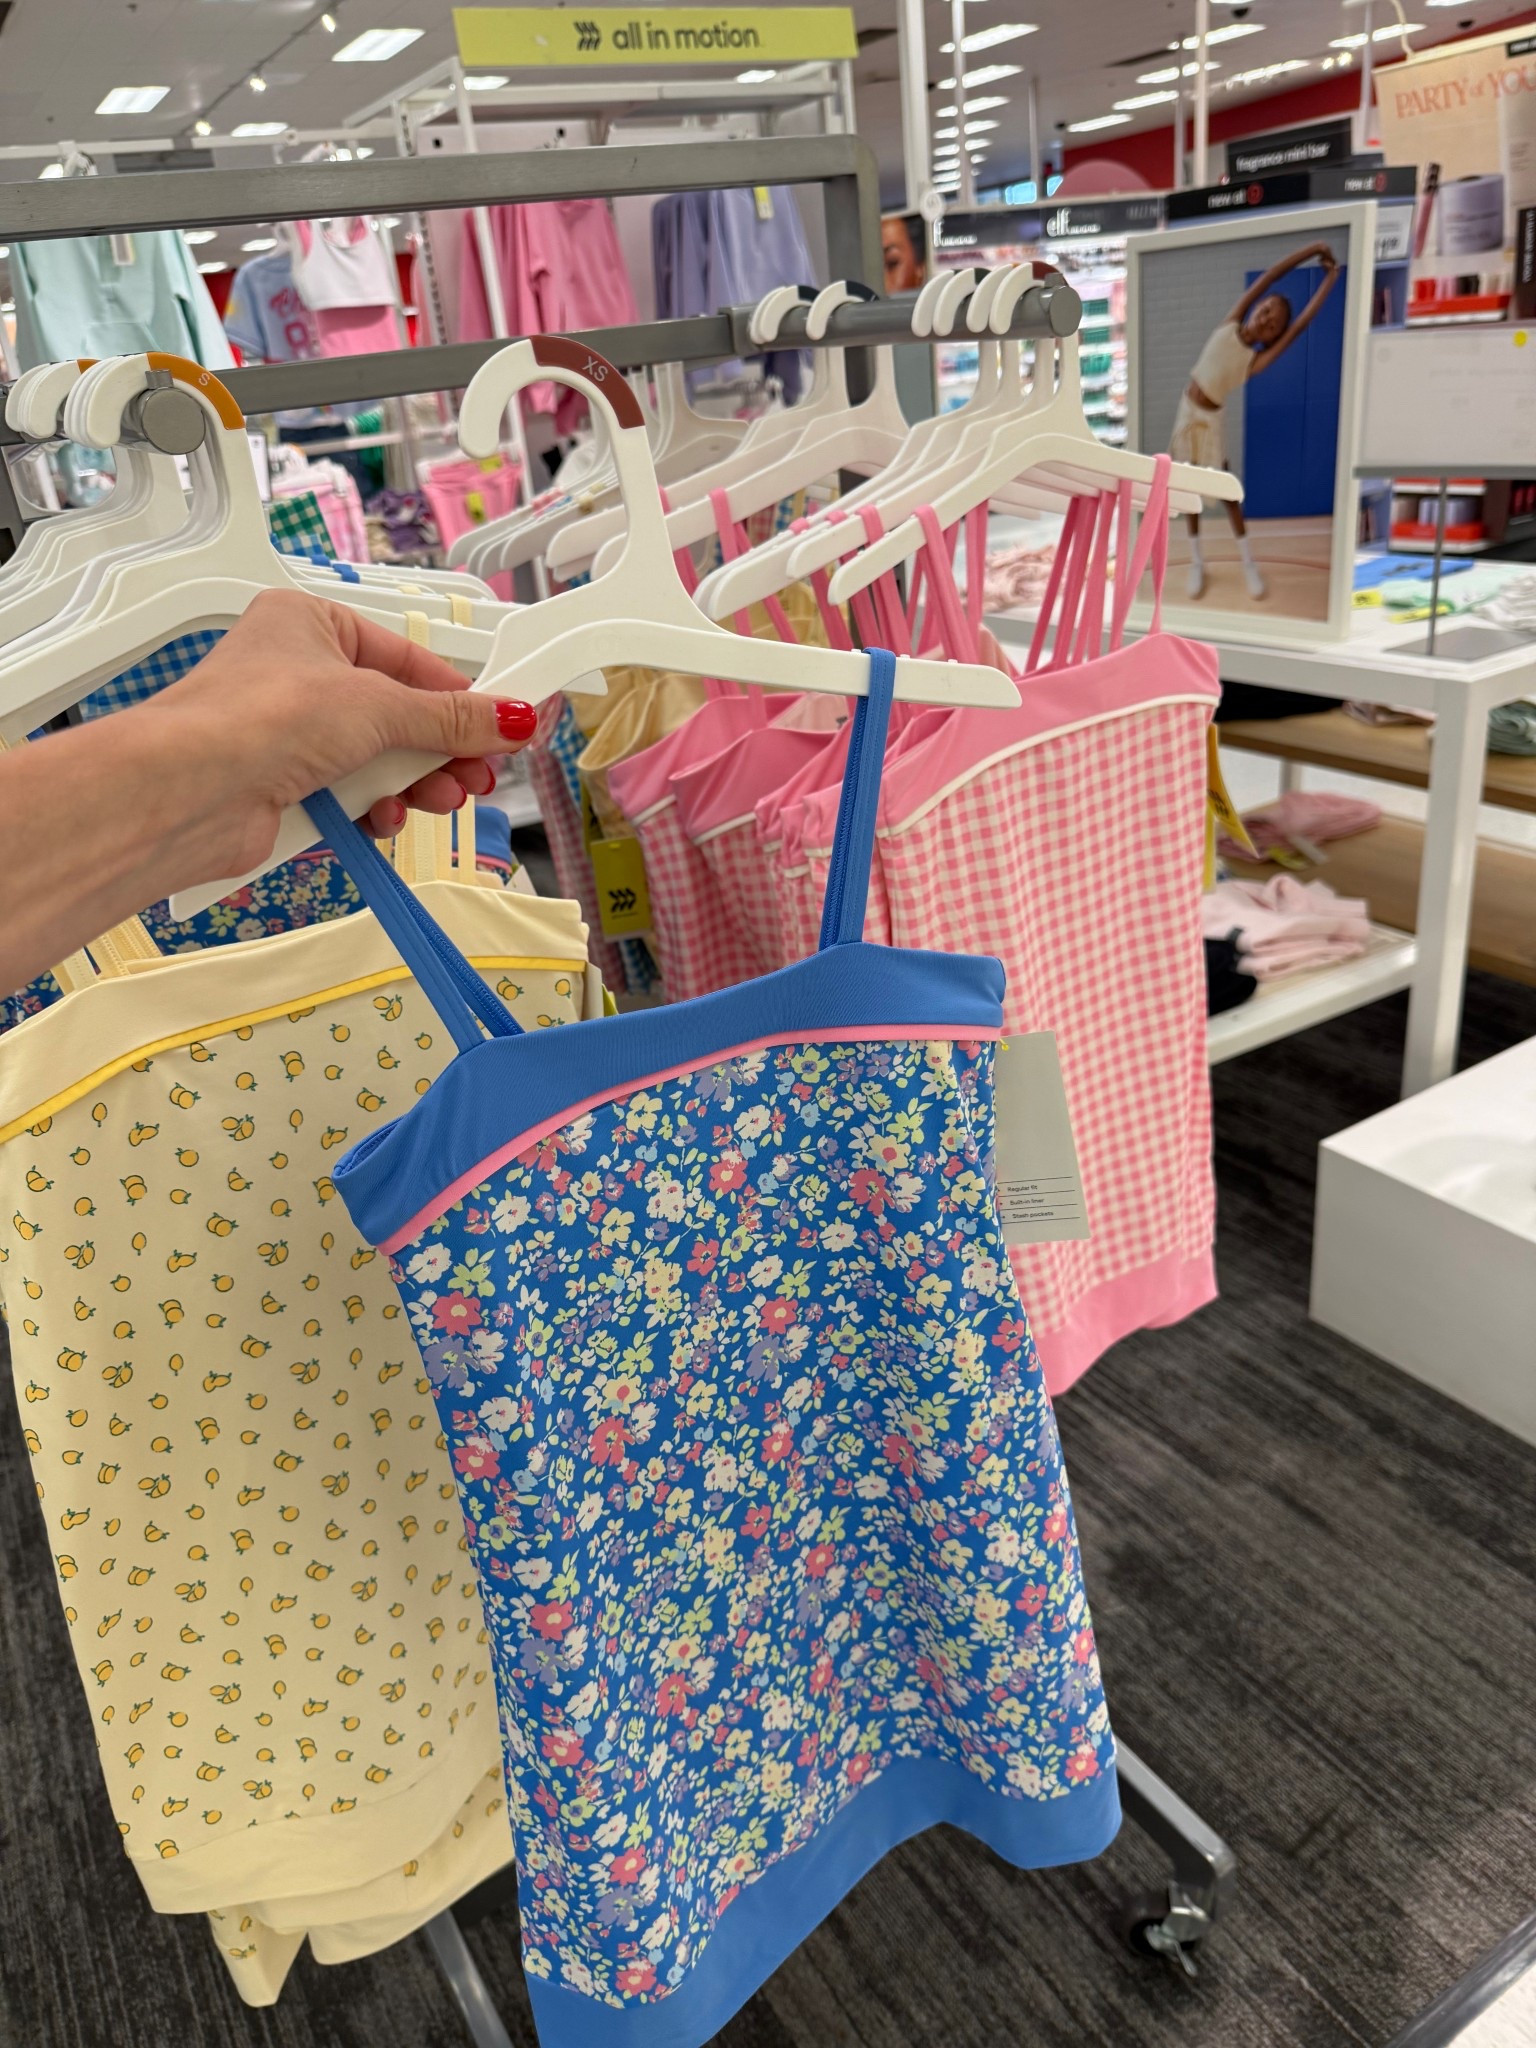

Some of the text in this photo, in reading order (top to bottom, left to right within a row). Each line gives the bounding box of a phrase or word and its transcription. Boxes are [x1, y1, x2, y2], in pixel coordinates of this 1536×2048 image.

[612, 21, 760, 50] all in motion
[1395, 77, 1469, 119] PARTY
[198, 372, 211, 386] S
[582, 355, 609, 382] XS
